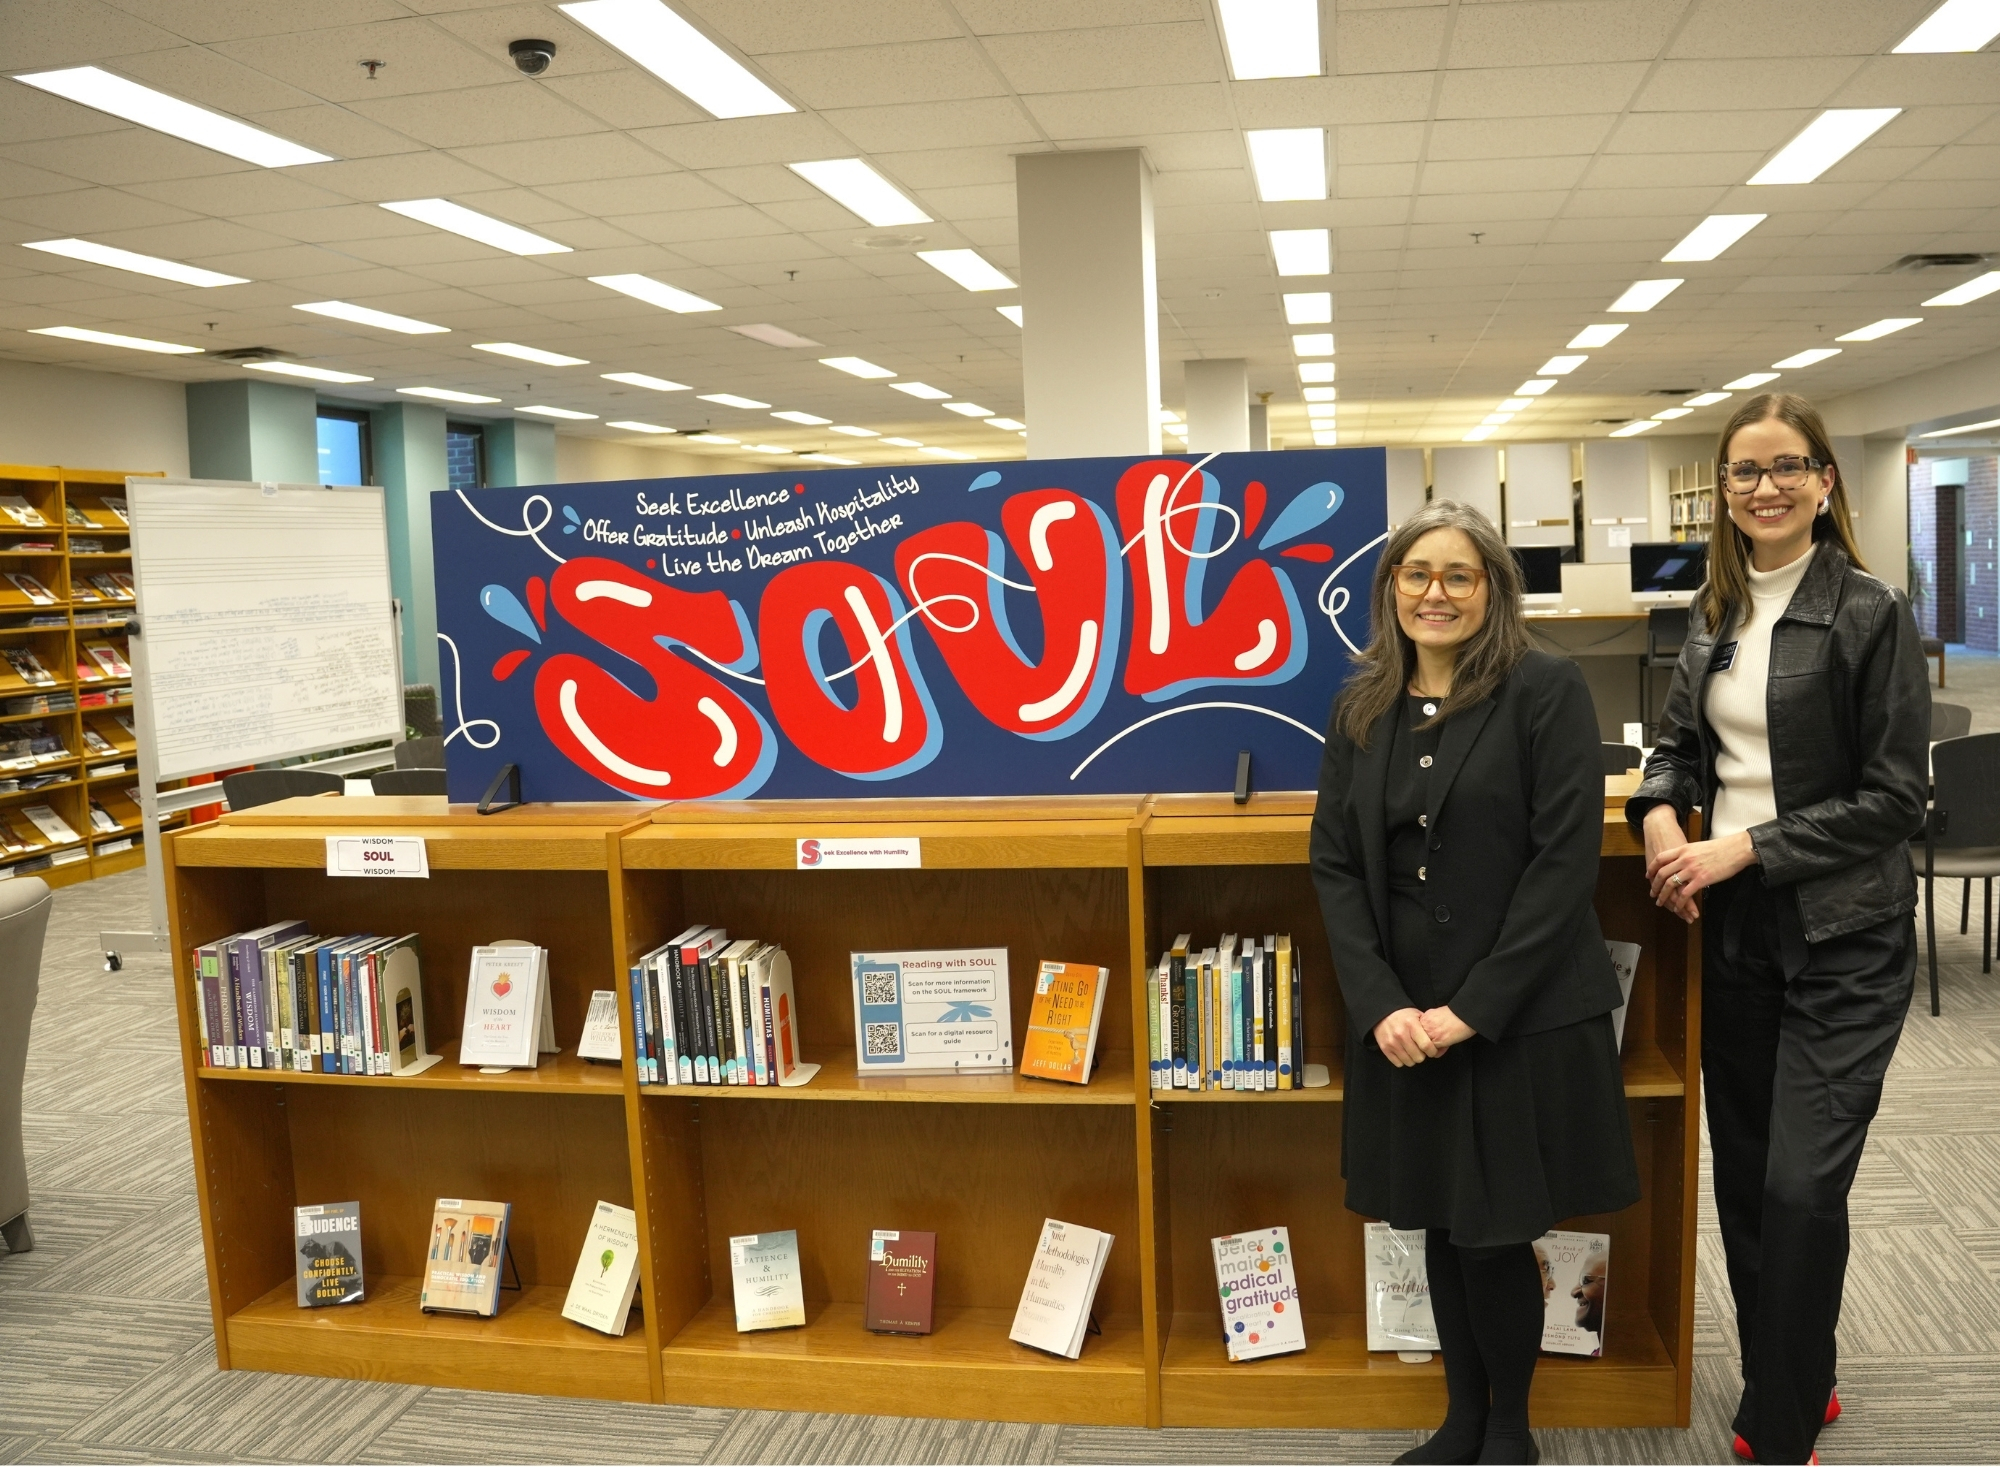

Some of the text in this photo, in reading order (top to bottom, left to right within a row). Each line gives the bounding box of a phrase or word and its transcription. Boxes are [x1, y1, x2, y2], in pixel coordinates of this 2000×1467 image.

[583, 475, 920, 547] Offer Gratitude Unleash Hospitality
[636, 488, 790, 516] Seek Excellence
[662, 513, 904, 577] Live the Dream Together
[534, 459, 1309, 801] SOUL
[363, 851, 394, 861] SOUL
[902, 958, 997, 970] Reading with SOUL
[676, 980, 682, 989] OF
[1160, 972, 1169, 1005] Thanks!
[234, 983, 242, 1011] Handbook
[721, 969, 732, 1038] Becoming by Beholding
[221, 986, 231, 1033] PHRONESIS
[245, 991, 255, 1031] WISDOM
[763, 997, 772, 1038] HUMILITAS
[1150, 999, 1158, 1038] GRATITUDE
[944, 1029, 965, 1037] digital
[1172, 1004, 1181, 1053] GRATITUDE
[606, 1236, 629, 1249] WISDOM
[315, 1258, 345, 1267] CHOOSE
[744, 1253, 788, 1264] PATIENCE
[879, 1250, 928, 1274] Humility
[1221, 1253, 1288, 1275] maiden
[1554, 1251, 1579, 1263] JOY
[746, 1273, 790, 1284] HUMILITY
[1035, 1259, 1067, 1279] Humility
[322, 1278, 339, 1287] LIVE
[1030, 1278, 1050, 1290] in the
[1222, 1269, 1282, 1292] radical
[316, 1288, 345, 1298] BOLDLY
[1026, 1290, 1065, 1312] Humanities
[1226, 1286, 1299, 1315] gratitude
[1228, 1310, 1271, 1321] Recalibrating
